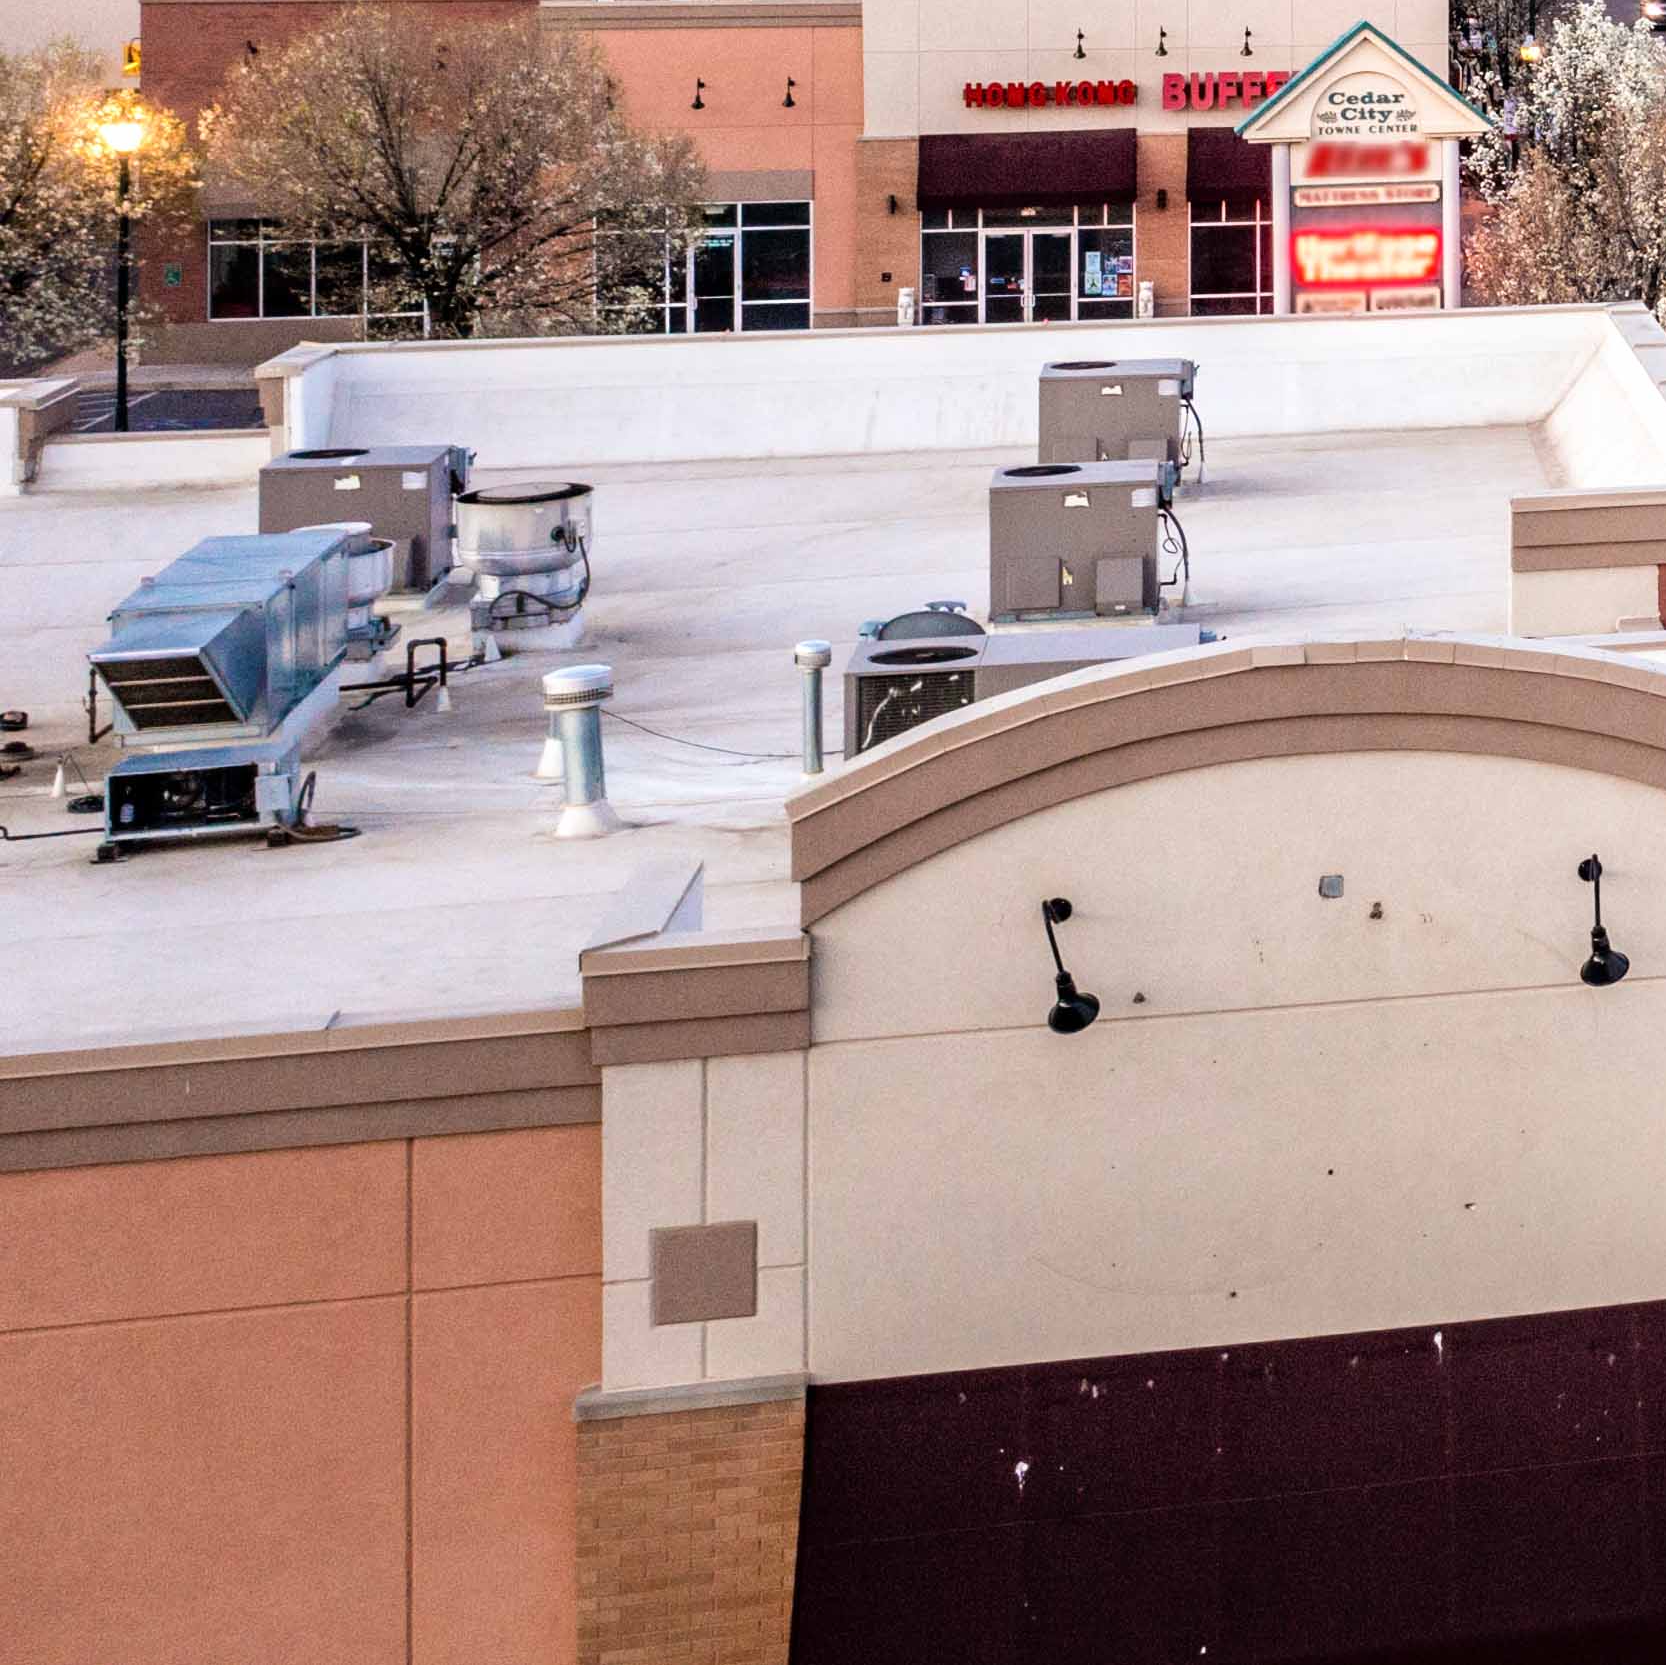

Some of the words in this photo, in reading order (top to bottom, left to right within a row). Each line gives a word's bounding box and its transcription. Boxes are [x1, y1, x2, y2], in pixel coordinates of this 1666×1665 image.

[964, 82, 1050, 108] HONG
[1055, 79, 1136, 106] KONG
[1162, 71, 1300, 111] BUFFE
[1328, 92, 1405, 105] Cedar
[1340, 107, 1393, 123] City
[1318, 125, 1361, 136] TOWNE
[1368, 123, 1418, 134] CENTER
